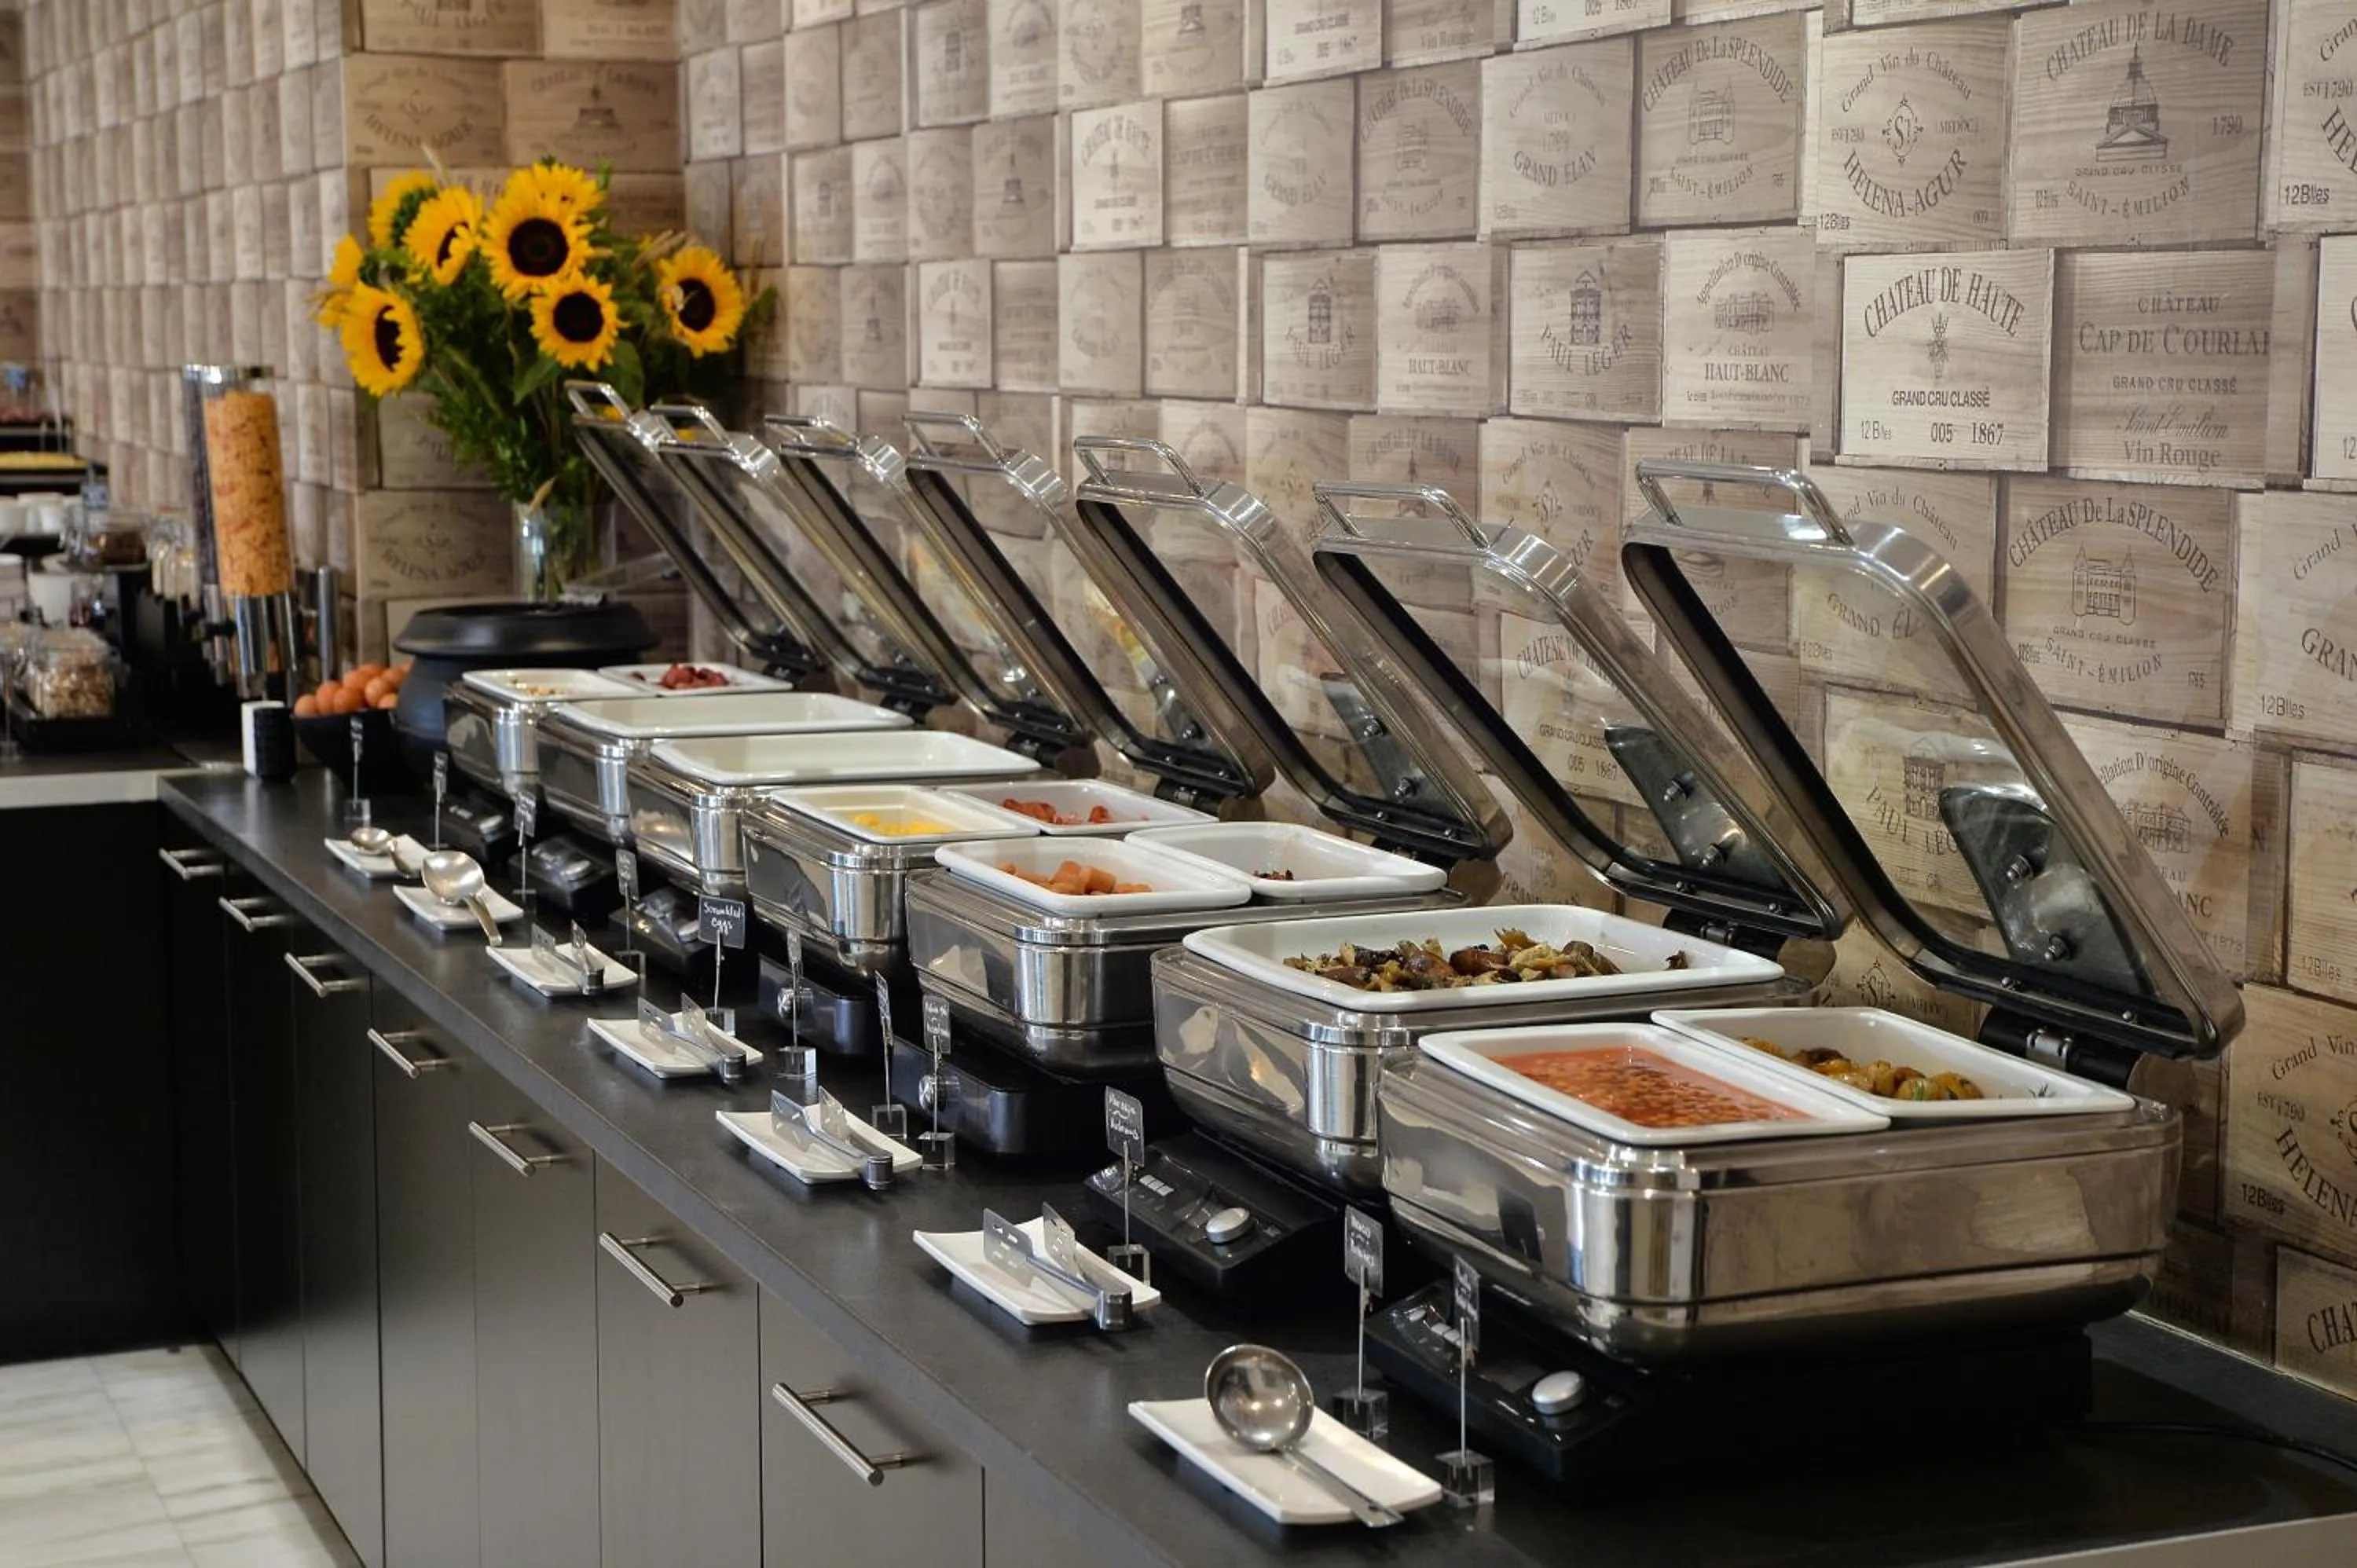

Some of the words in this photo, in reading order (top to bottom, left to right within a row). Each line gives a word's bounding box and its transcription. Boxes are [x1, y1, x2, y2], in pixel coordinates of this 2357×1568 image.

[2126, 12, 2148, 42] DE
[2154, 10, 2176, 41] LA
[1864, 268, 1937, 338] CHATEAU
[1939, 266, 1963, 303] DE
[1965, 273, 2025, 338] HAUTE
[1892, 390, 1926, 407] GRAND
[1927, 391, 1949, 407] CRU
[2113, 375, 2154, 391] GRAND
[2158, 376, 2183, 391] CRU
[1930, 423, 1954, 443] 005
[2161, 442, 2223, 473] Rouge
[2293, 528, 2341, 581] Grand
[2272, 1036, 2318, 1081] Grand
